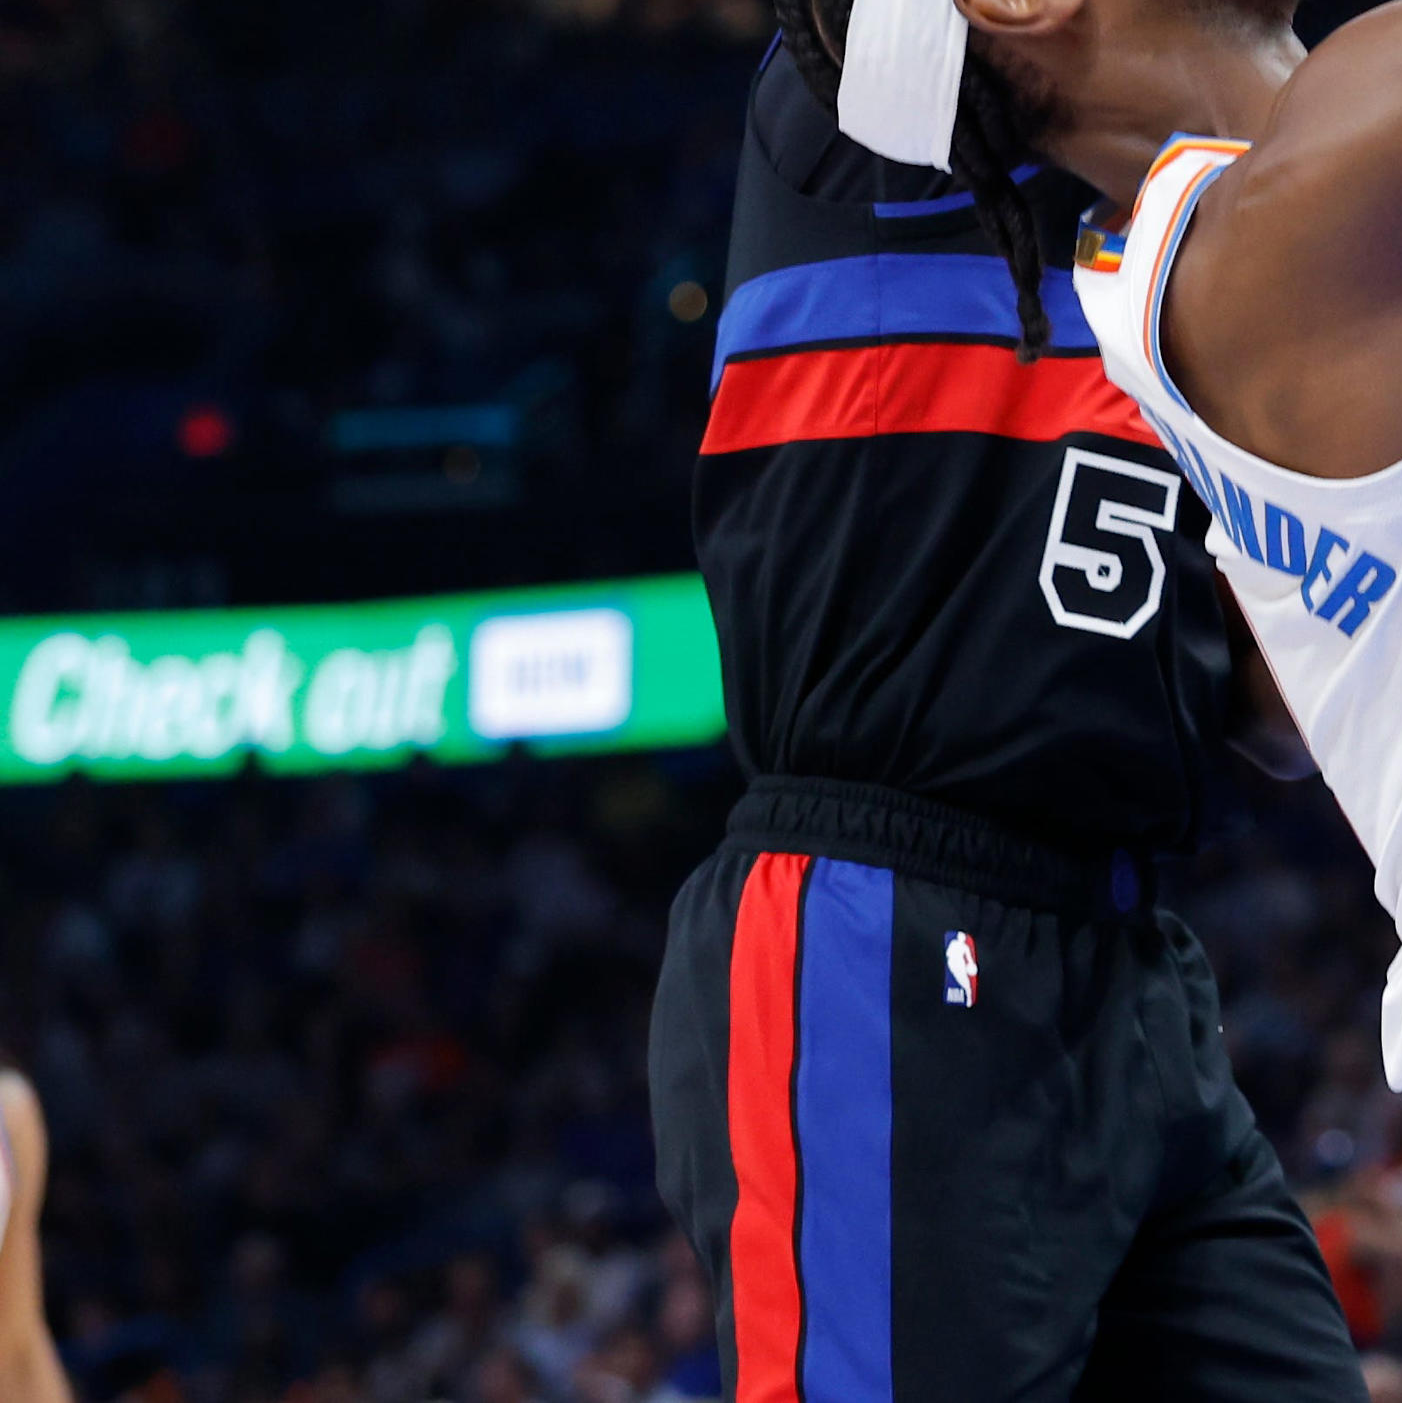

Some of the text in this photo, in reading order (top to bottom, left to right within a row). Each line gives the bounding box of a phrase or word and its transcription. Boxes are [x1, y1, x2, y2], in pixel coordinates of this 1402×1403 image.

[1038, 445, 1181, 640] 5
[8, 630, 302, 766] Check
[304, 620, 458, 756] out
